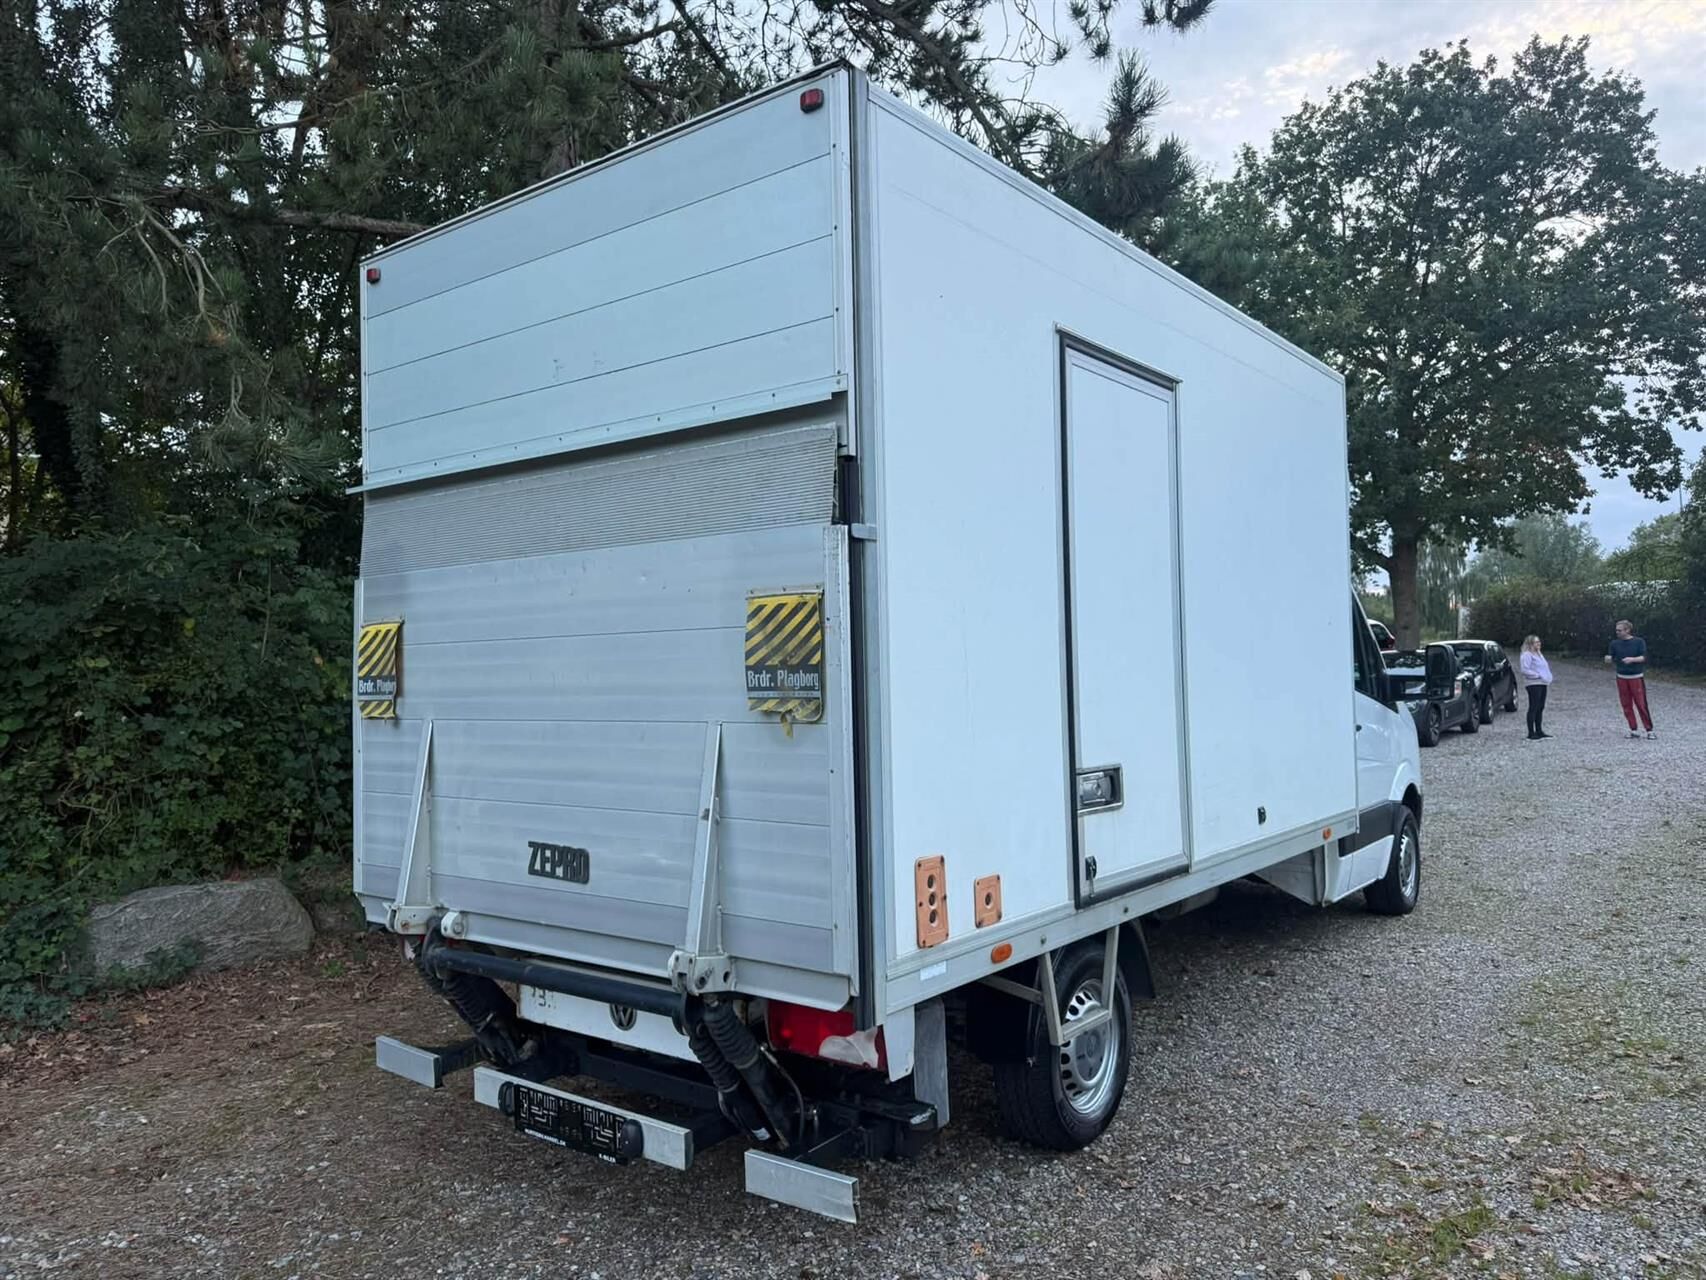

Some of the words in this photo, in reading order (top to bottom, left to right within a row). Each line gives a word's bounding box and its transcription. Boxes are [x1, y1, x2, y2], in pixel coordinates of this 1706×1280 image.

[359, 680, 376, 693] Brdr.
[747, 670, 775, 688] Brdr.
[777, 670, 819, 690] Plagborg
[528, 841, 590, 885] ZEPRO
